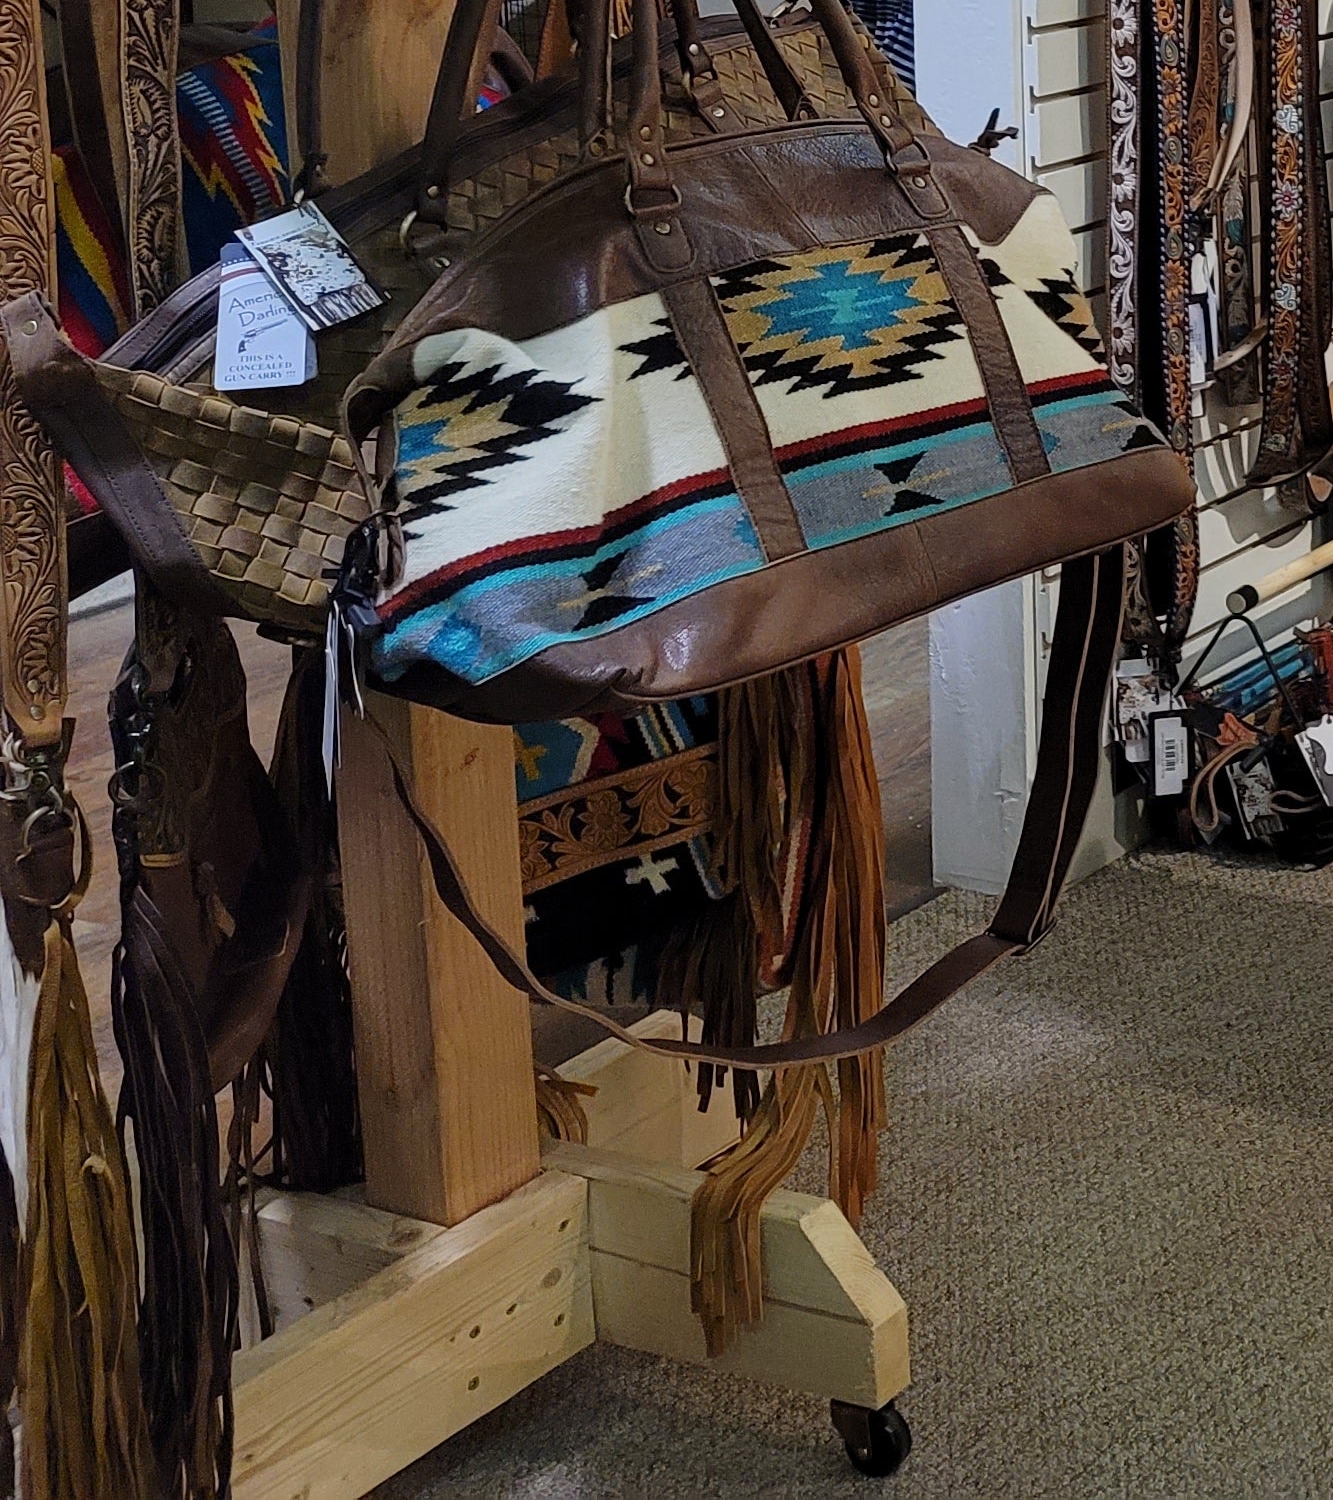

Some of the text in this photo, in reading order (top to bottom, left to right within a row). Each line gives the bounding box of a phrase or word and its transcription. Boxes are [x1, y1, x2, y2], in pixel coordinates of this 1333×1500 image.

[240, 355, 263, 363] THIS
[265, 353, 274, 361] IS
[229, 361, 292, 373] CONCEALED
[224, 374, 246, 382] GUN
[249, 371, 282, 380] CARRY
